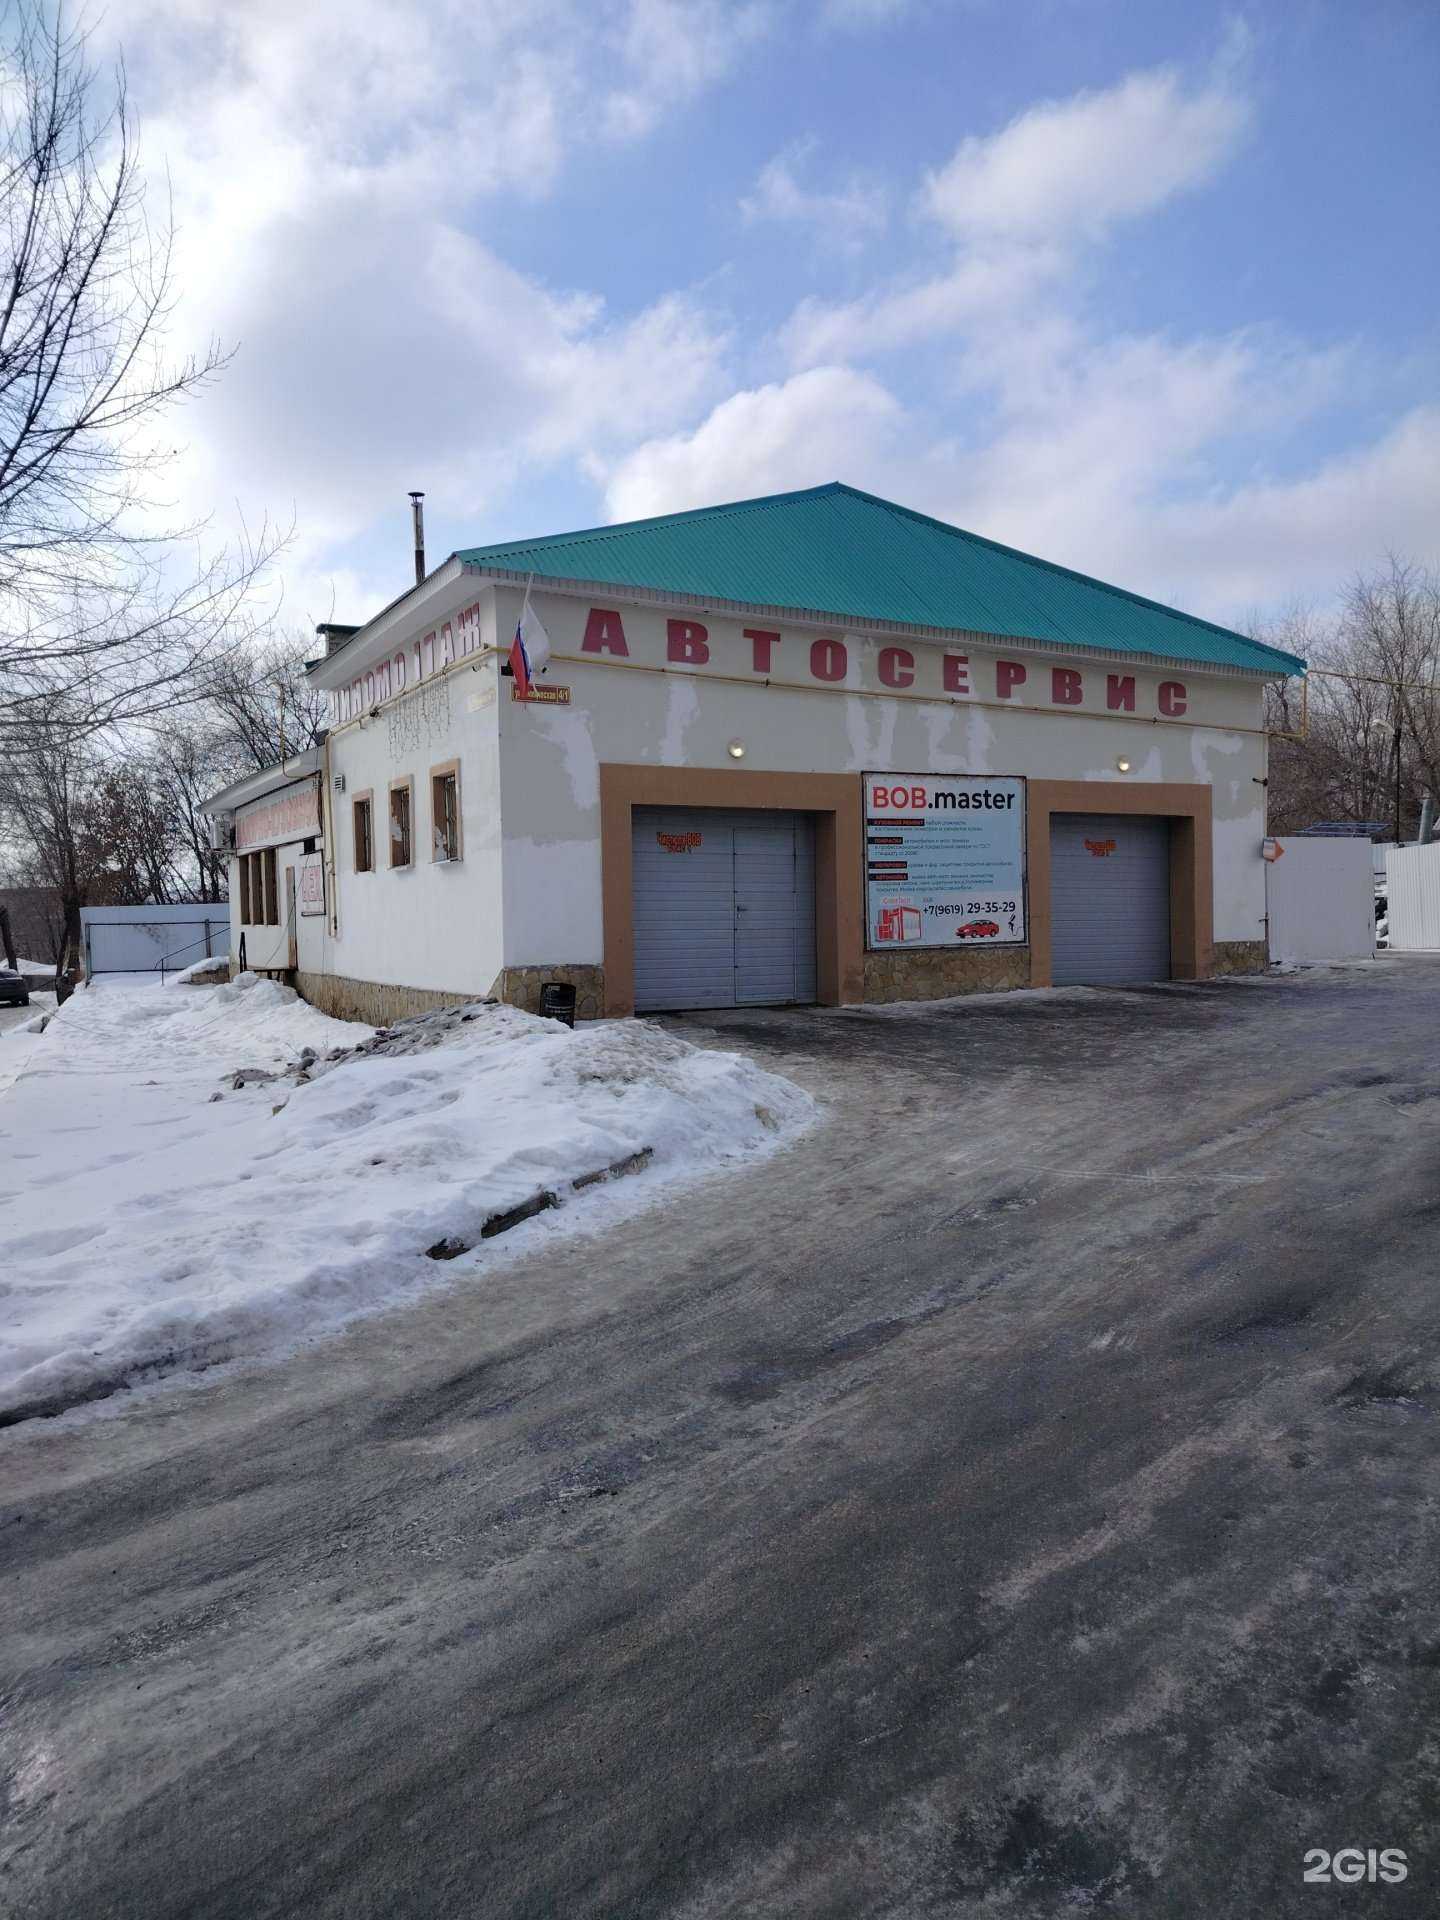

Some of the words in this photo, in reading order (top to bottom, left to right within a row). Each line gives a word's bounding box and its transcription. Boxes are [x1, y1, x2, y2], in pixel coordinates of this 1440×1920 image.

[580, 608, 1188, 717] АВТОСЕРВИС
[923, 904, 964, 917] +7(9619)
[967, 901, 1016, 914] 29-35-29
